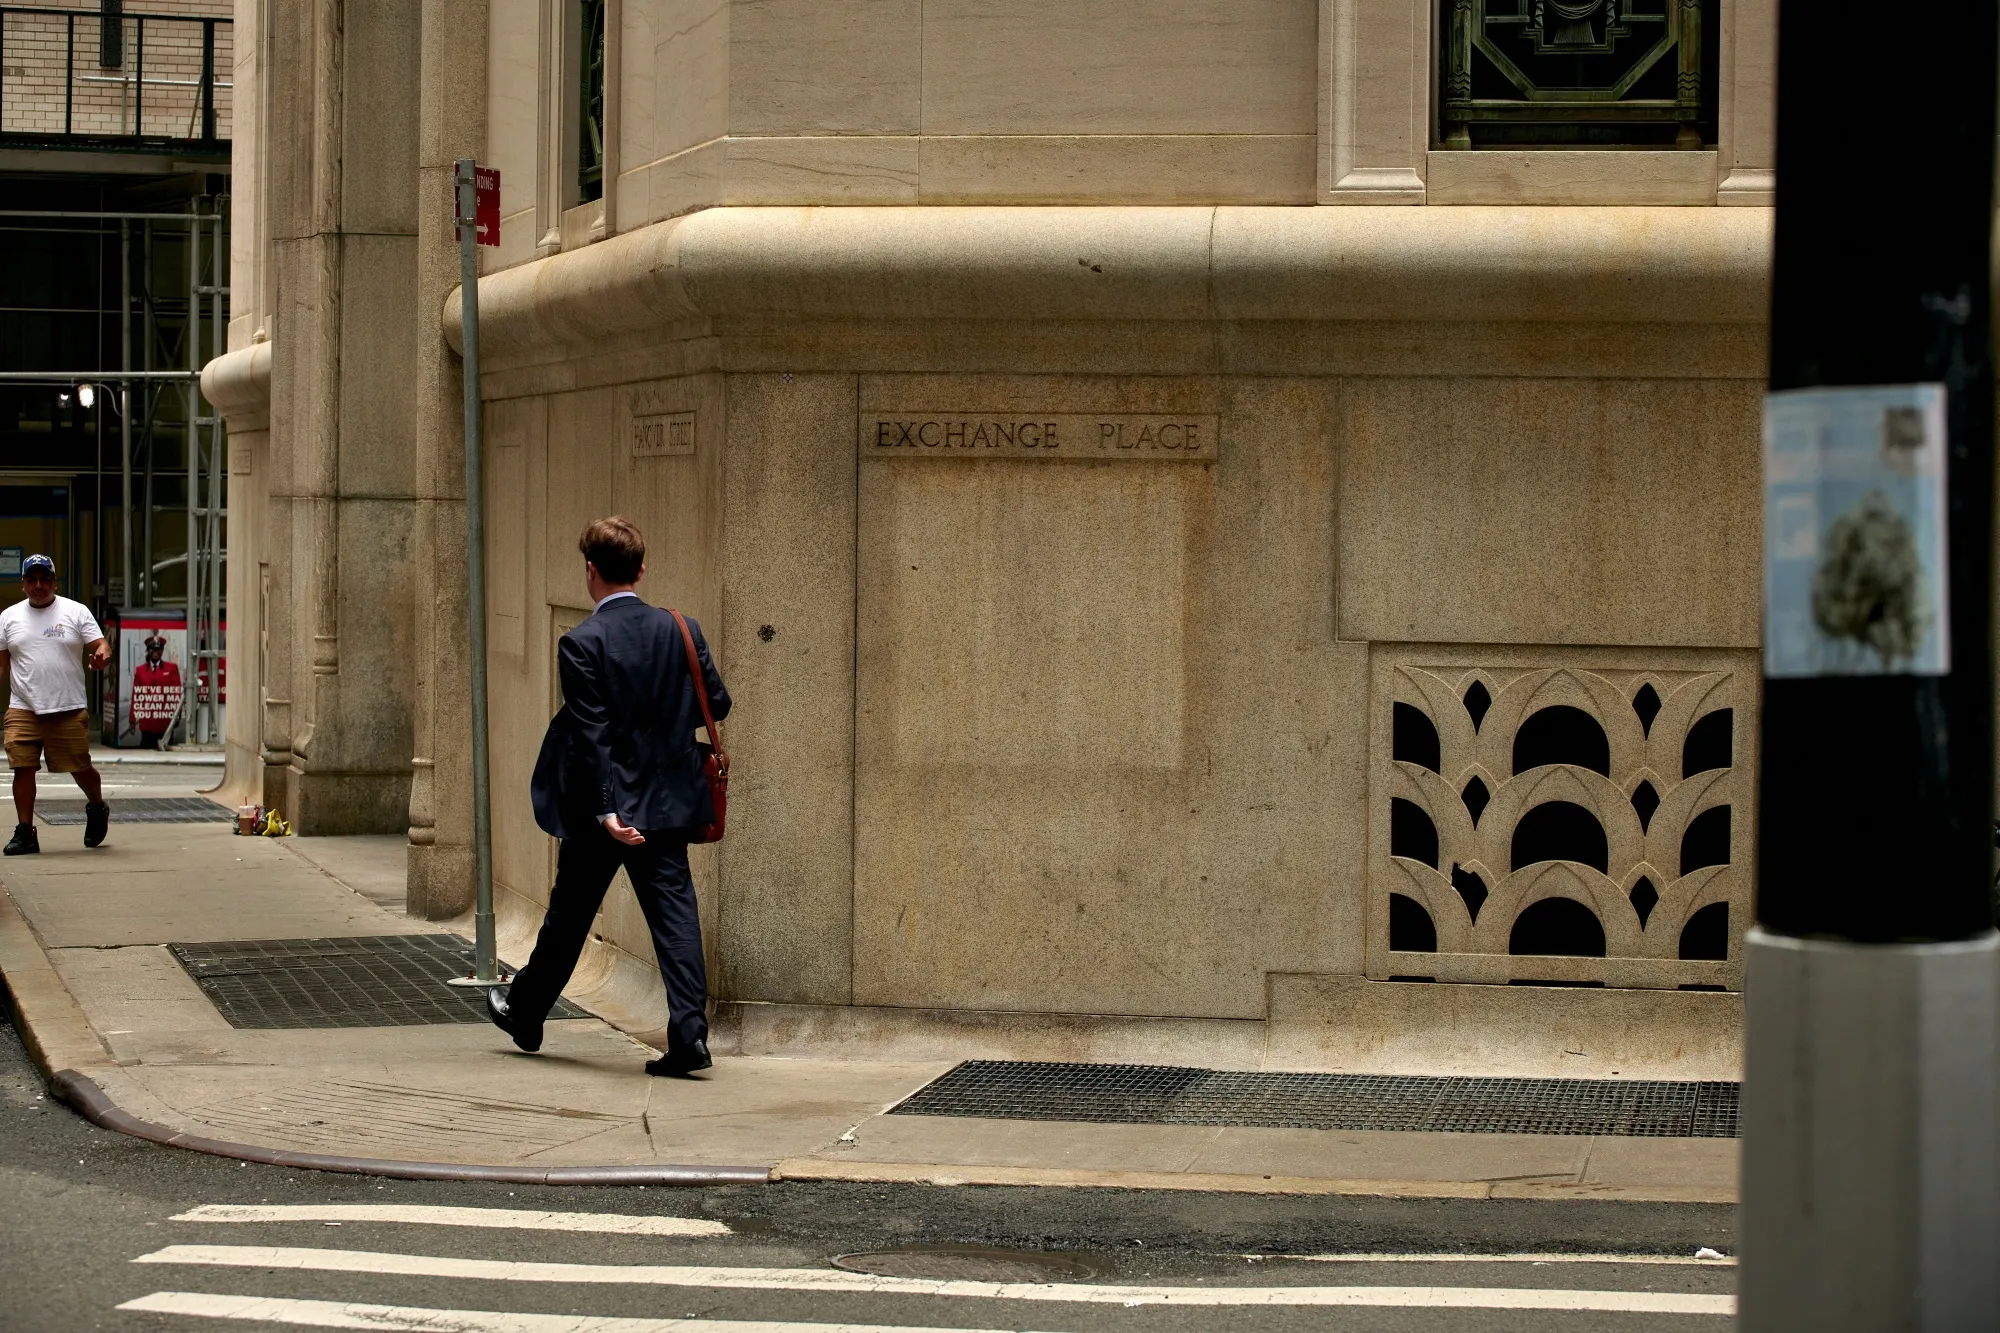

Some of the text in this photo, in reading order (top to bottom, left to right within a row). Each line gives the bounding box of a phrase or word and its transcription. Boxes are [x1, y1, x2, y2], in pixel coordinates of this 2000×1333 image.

[476, 175, 493, 191] NDING
[876, 420, 1202, 451] EXCHANGE PLACE
[134, 685, 162, 694] WE'VE
[133, 694, 164, 702] LOWER
[133, 702, 162, 711] CLEAN
[133, 711, 175, 719] YOU SINC
